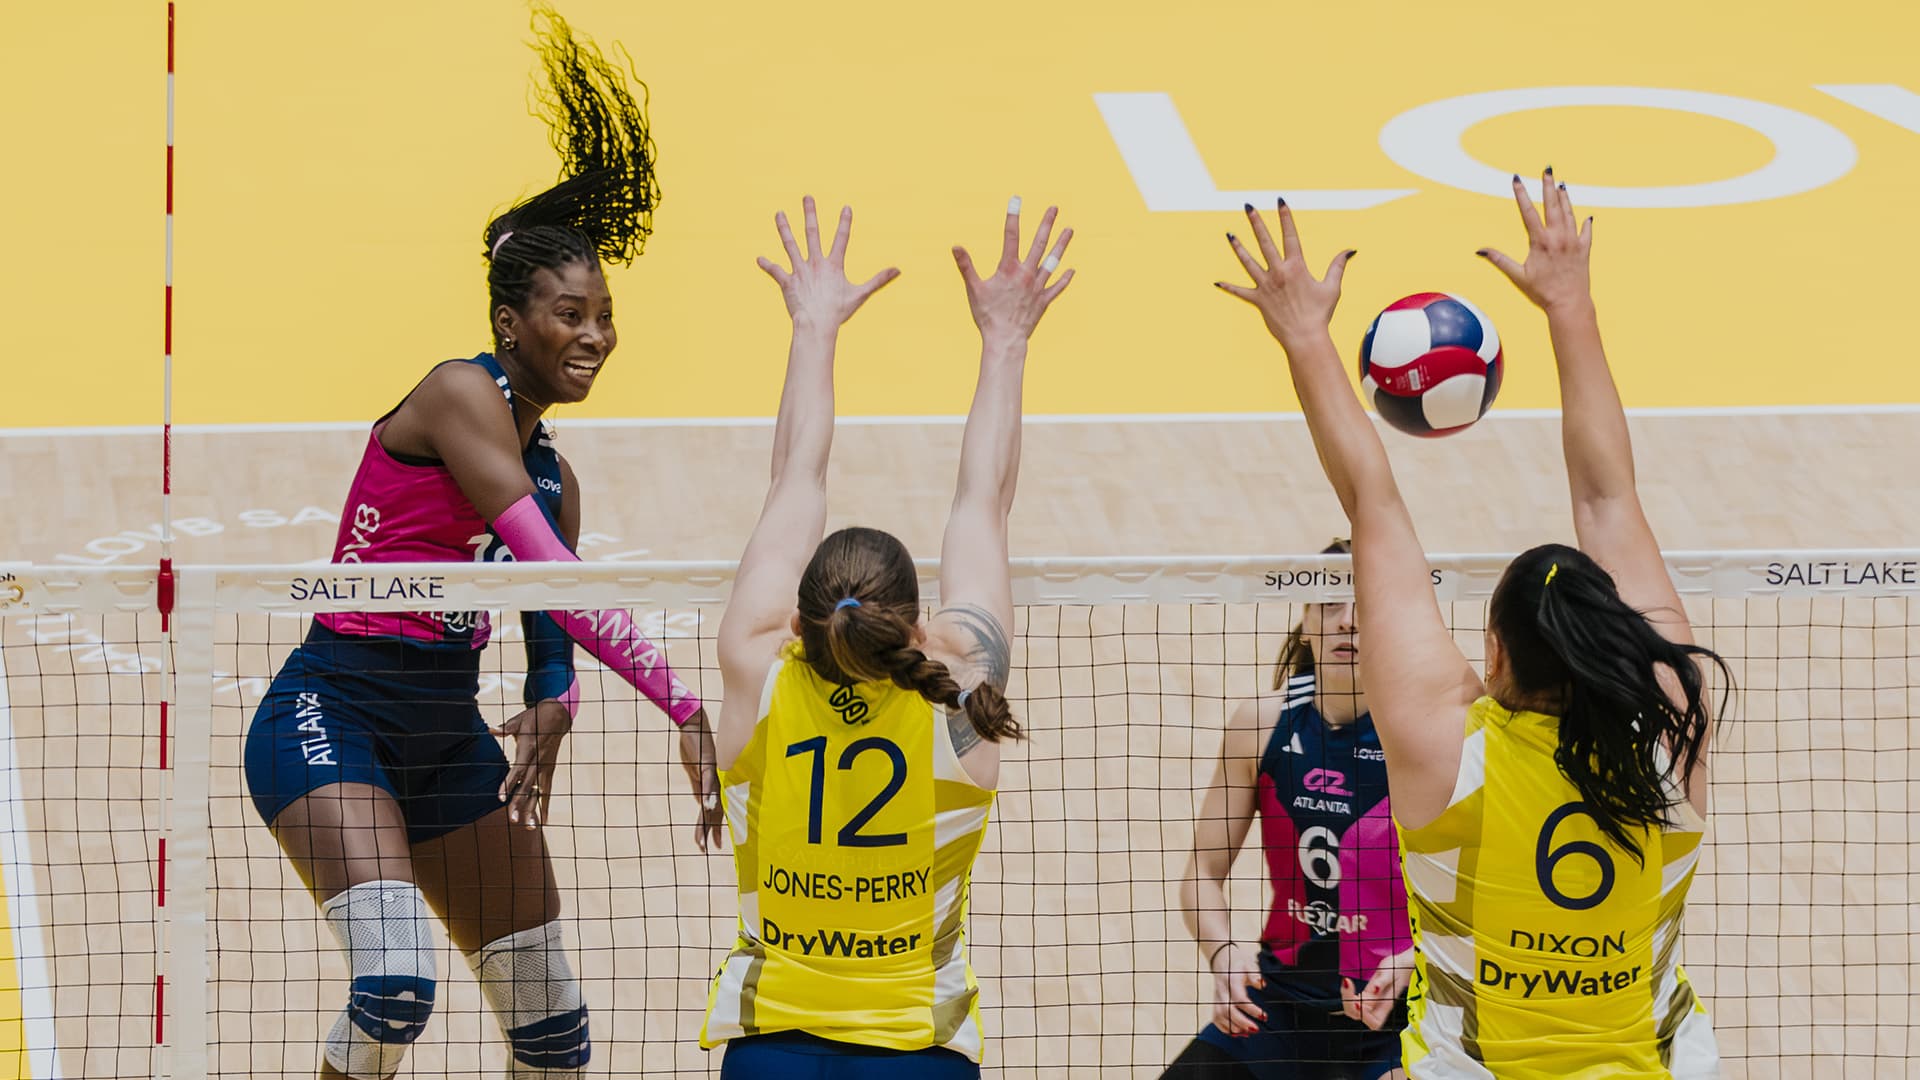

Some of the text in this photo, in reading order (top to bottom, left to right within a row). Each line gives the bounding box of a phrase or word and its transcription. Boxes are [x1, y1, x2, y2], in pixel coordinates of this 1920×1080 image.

[290, 576, 445, 600] SALT LAKE
[1766, 562, 1918, 585] SALT LAKE
[785, 735, 908, 847] 12
[1293, 795, 1351, 815] ATLANTA
[1298, 825, 1342, 890] 6
[1535, 801, 1616, 911] 6
[763, 864, 931, 903] JONES-PERRY
[762, 917, 921, 958] DryWater
[1509, 929, 1626, 958] DIXON
[1479, 958, 1642, 998] DryWater
